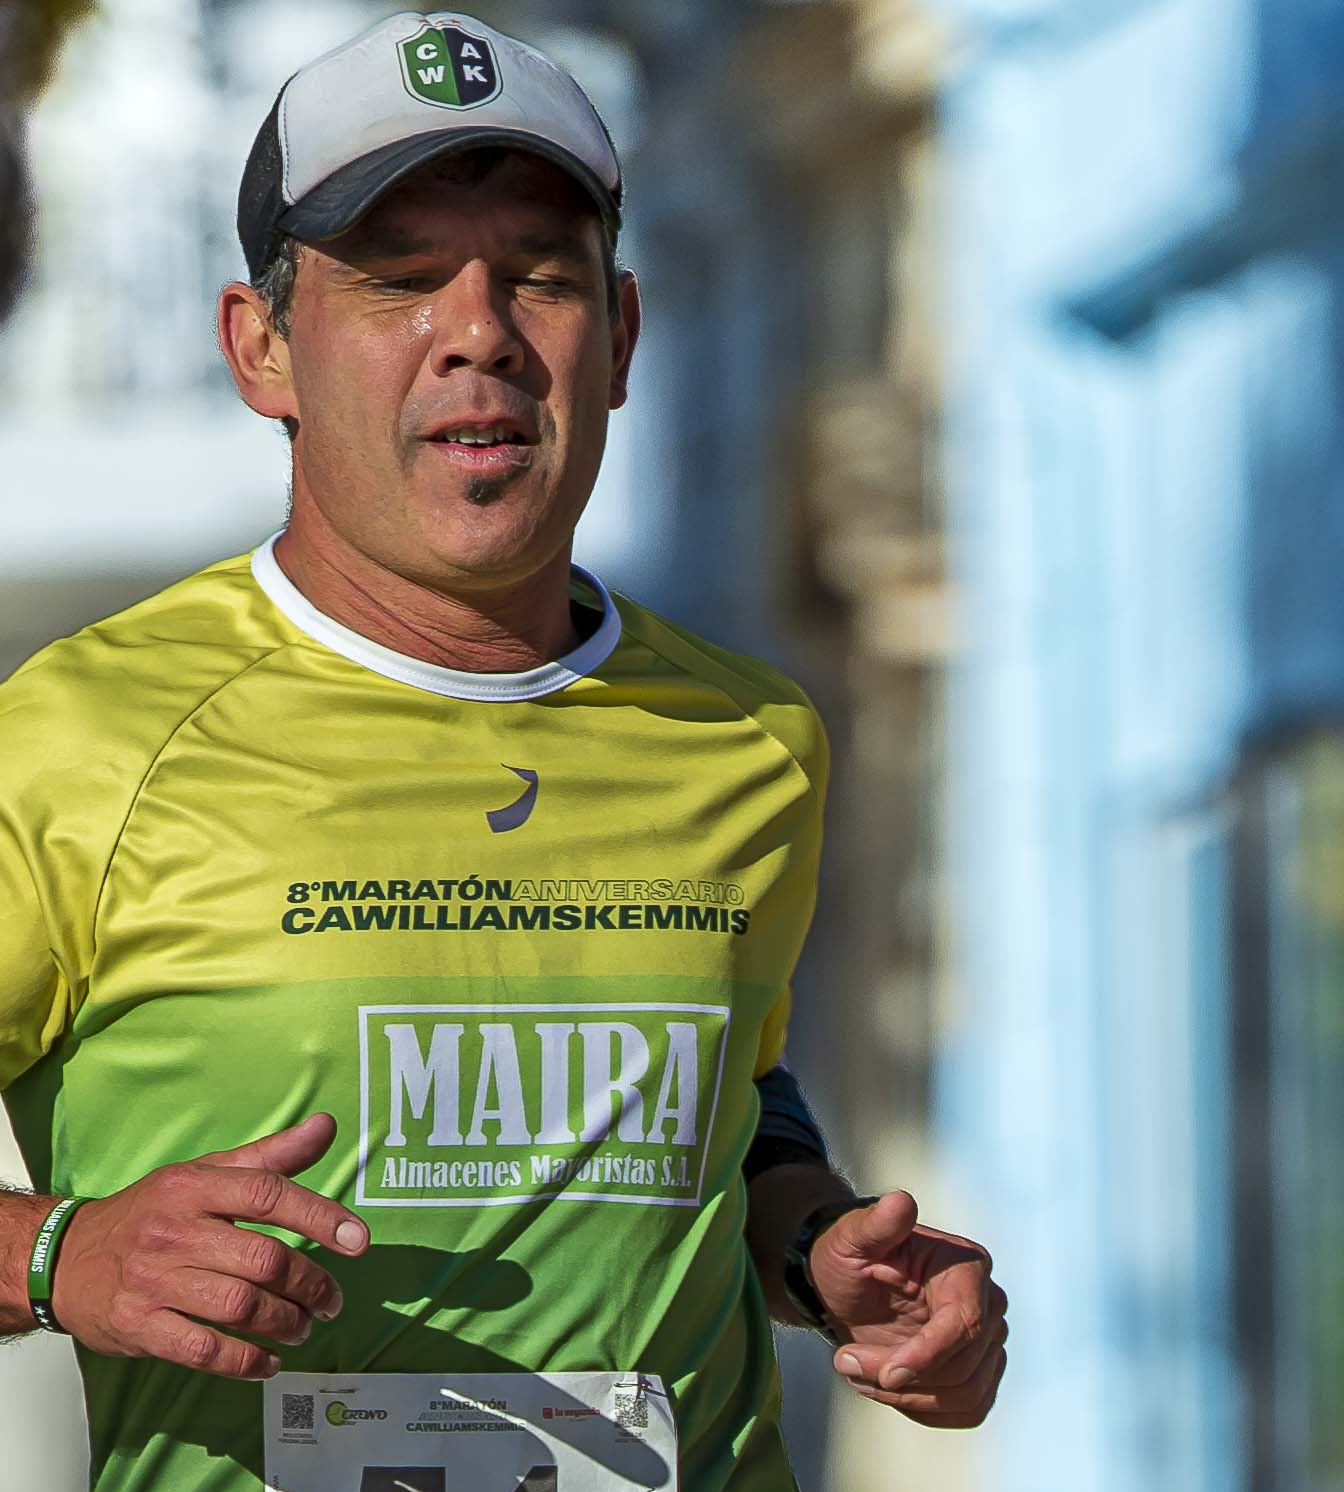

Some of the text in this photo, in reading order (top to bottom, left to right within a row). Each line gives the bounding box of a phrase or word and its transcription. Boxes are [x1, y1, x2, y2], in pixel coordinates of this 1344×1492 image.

[416, 42, 482, 60] C A
[417, 64, 488, 85] W K
[383, 1022, 698, 1147] MAIRA
[379, 1157, 522, 1189] Almacenes
[30, 1232, 53, 1273] KEMMIS
